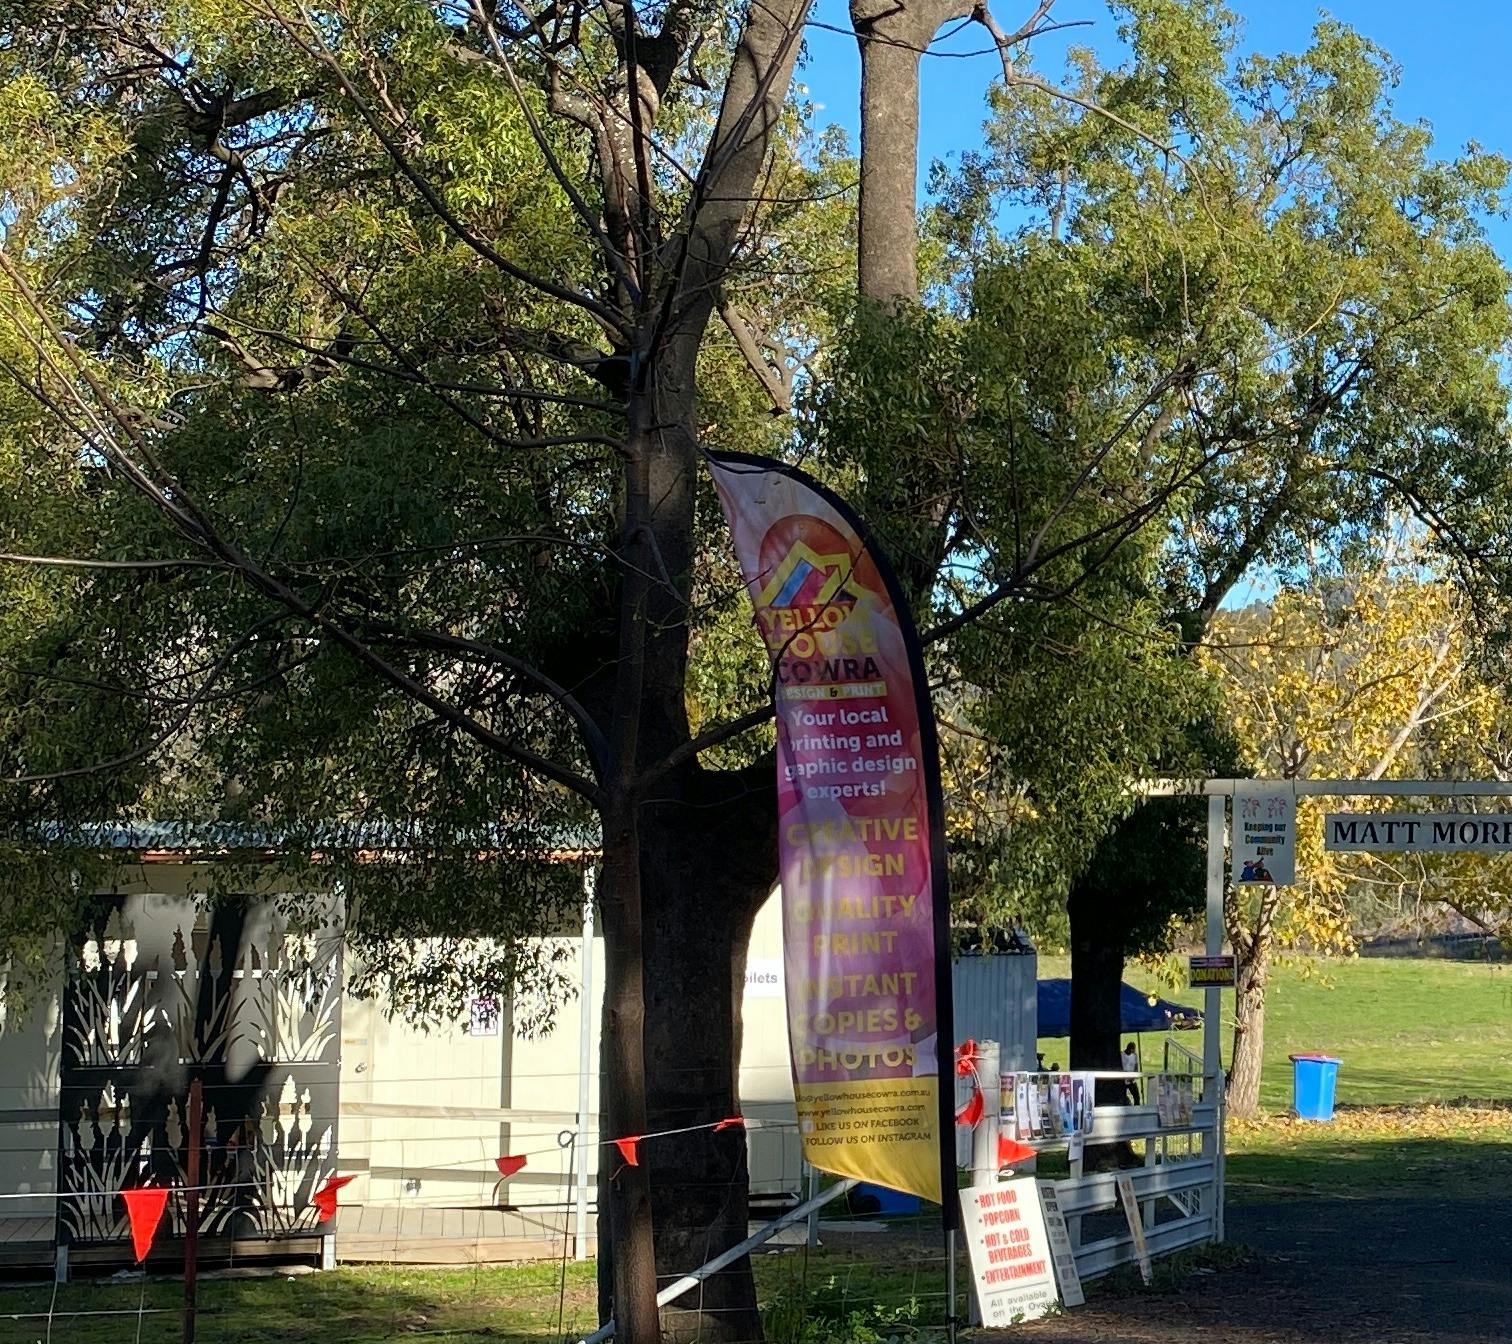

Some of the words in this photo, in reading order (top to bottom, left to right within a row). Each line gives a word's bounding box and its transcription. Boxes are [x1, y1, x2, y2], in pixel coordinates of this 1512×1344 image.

[842, 684, 882, 696] PRINT
[790, 710, 836, 726] Your
[840, 706, 889, 725] local
[866, 729, 902, 747] and
[851, 755, 917, 774] design
[807, 780, 886, 801] experts!
[1333, 821, 1421, 844] MATT
[813, 930, 898, 957] PRINT
[904, 1008, 922, 1031] &
[839, 1121, 851, 1129] US
[853, 1120, 868, 1129] ON
[870, 1118, 920, 1128] FACEBOOK
[846, 1136, 858, 1145] US
[861, 1135, 875, 1144] ON
[997, 1189, 1018, 1205] FOOD
[983, 1208, 1021, 1227] POPCORN
[1009, 1227, 1030, 1244] COLD
[988, 1243, 1033, 1264] BEVERAGES
[985, 1259, 1047, 1285] ENTERTAINMENT
[991, 1298, 1003, 1309] All
[1007, 1290, 1048, 1305] available
[992, 1310, 1005, 1318] on
[1010, 1305, 1024, 1314] the
